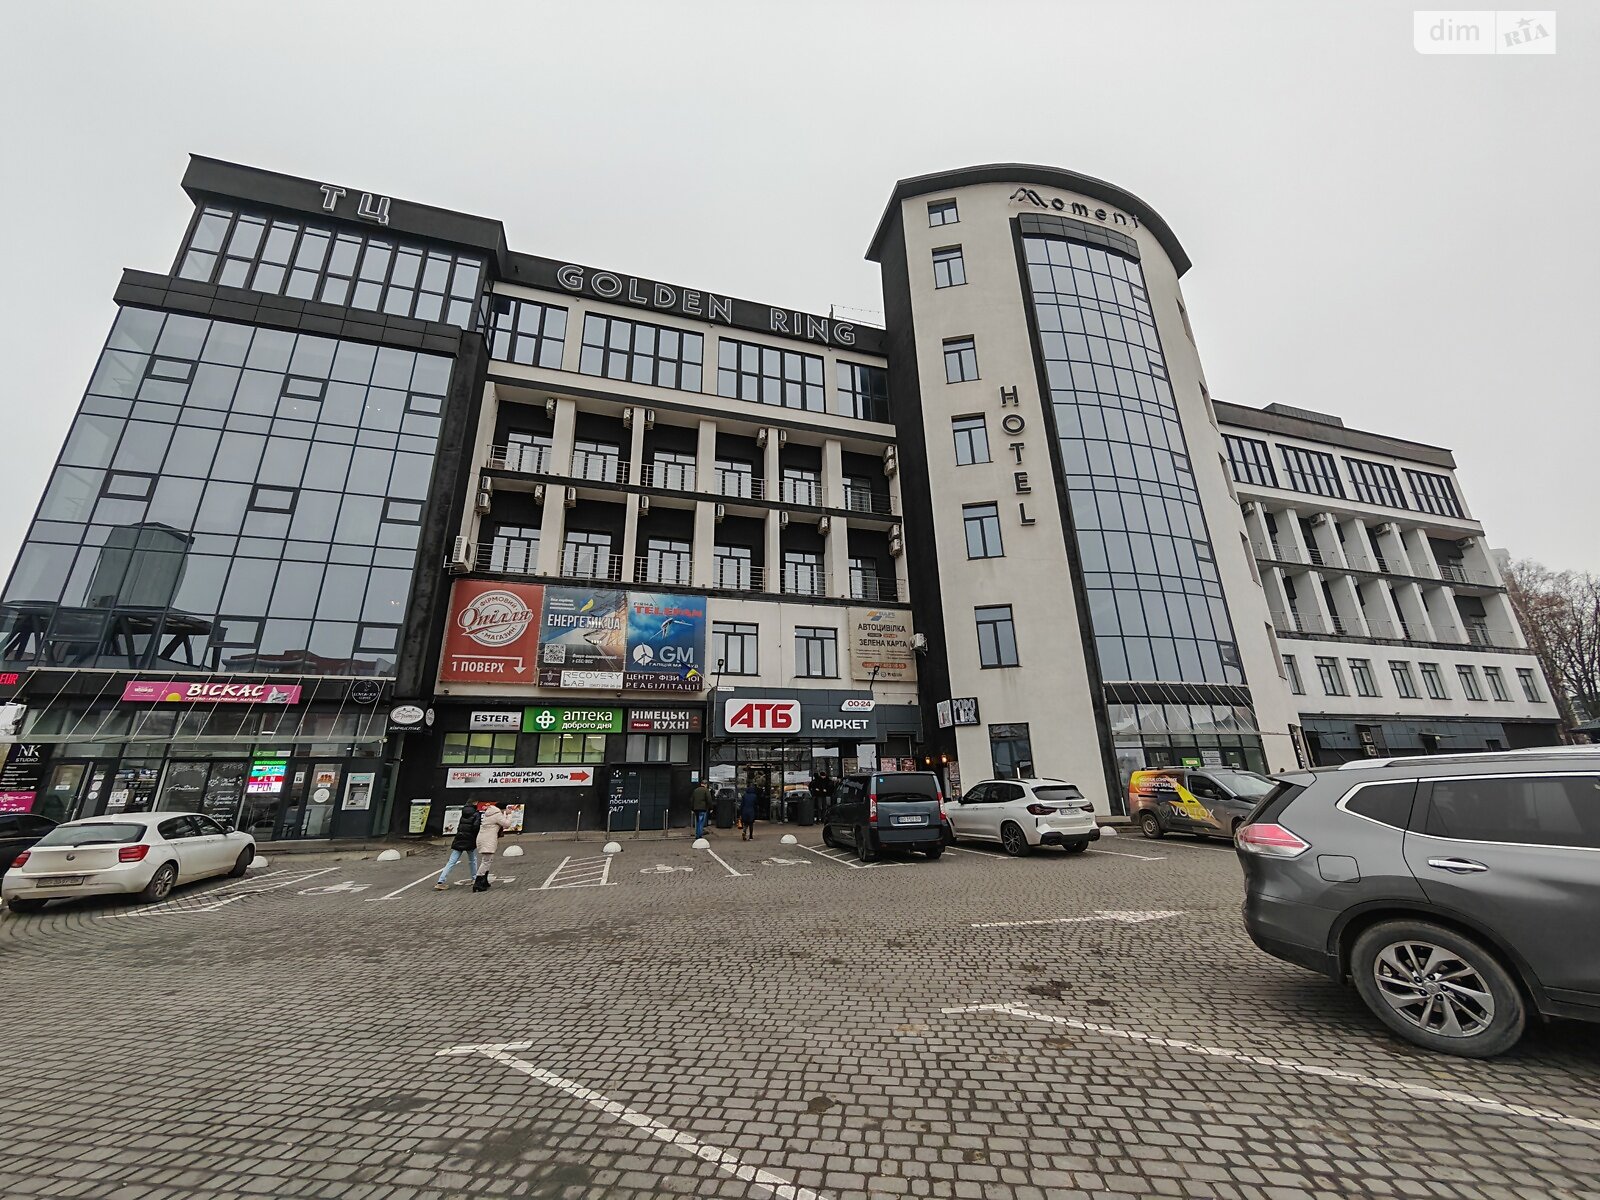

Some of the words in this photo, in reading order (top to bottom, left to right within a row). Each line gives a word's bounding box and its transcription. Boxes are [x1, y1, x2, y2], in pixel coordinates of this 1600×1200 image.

[320, 184, 391, 226] ТЦ
[1009, 187, 1139, 228] Moment
[557, 264, 732, 324] GOLDEN
[770, 307, 856, 345] RING
[1000, 385, 1036, 526] HOTEL
[480, 596, 518, 609] ФІРМОВИЙ
[459, 608, 533, 628] Опілля
[484, 627, 516, 641] МАГАЗИН
[858, 624, 906, 633] АВТОЦИВІЛКА
[859, 639, 886, 647] ЗЕЛЕНА
[660, 646, 694, 664] GM
[452, 661, 458, 672] 1
[461, 661, 504, 673] ПОВЕРХ
[563, 672, 622, 680] RECOVERY
[626, 673, 655, 681] ЦЕНТР
[625, 682, 701, 691] РЕАБІЛІТАЦІЇ
[474, 714, 509, 723] ESTER
[563, 711, 613, 721] аптека
[631, 710, 689, 721] НІМЕЦЬКІ
[730, 703, 795, 729] АТБ
[562, 721, 596, 730] доброго
[597, 722, 612, 730] дня
[653, 721, 689, 730] КУХНІ
[811, 719, 869, 730] МАРКЕТ
[18, 744, 41, 757] NK
[1171, 806, 1216, 820] VOLTOX
